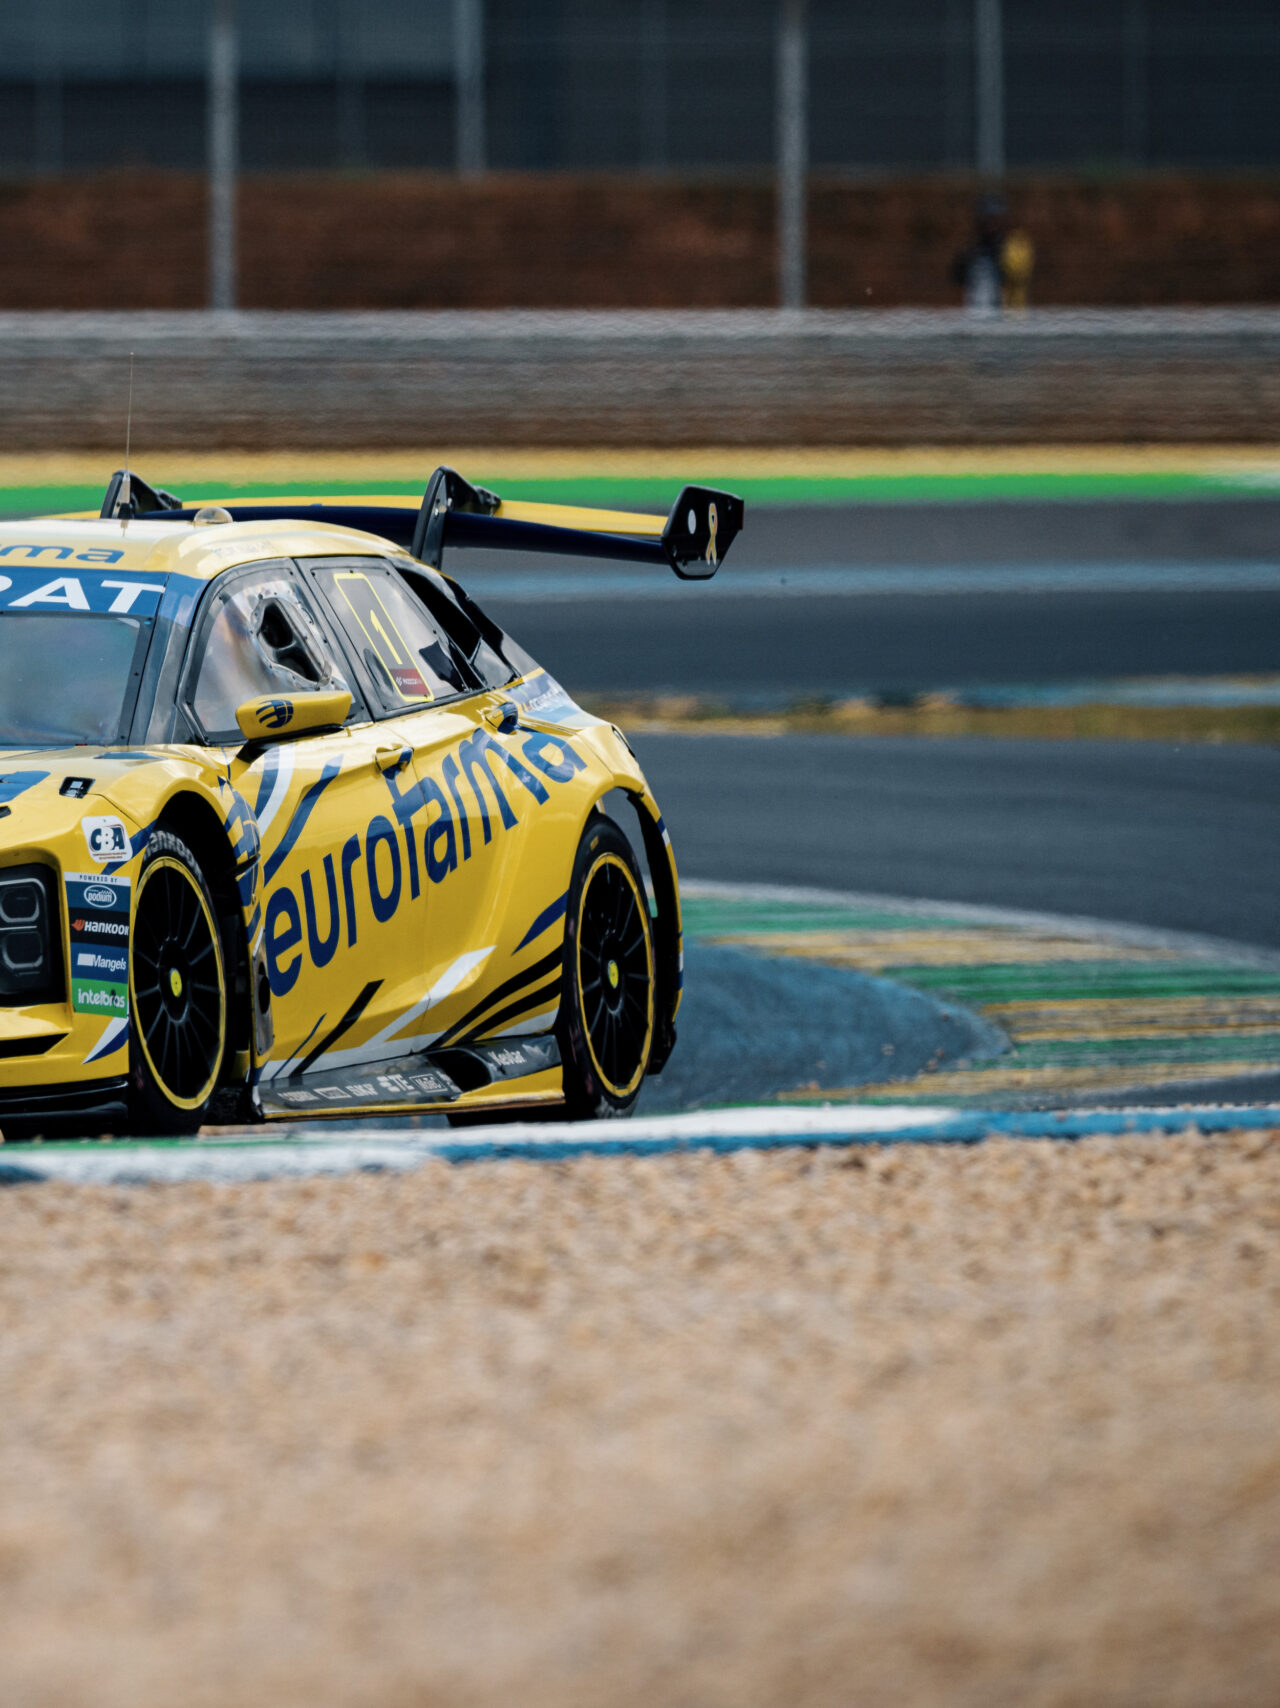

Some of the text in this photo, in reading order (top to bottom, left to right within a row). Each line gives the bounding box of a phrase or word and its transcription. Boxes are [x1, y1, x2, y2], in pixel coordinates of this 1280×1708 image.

[369, 609, 404, 665] 1
[90, 826, 126, 851] CBA
[265, 727, 588, 998] eurofarma
[79, 874, 108, 883] POWERED
[88, 891, 113, 903] podium
[93, 954, 127, 972] Mangels
[78, 988, 126, 1008] intelbras
